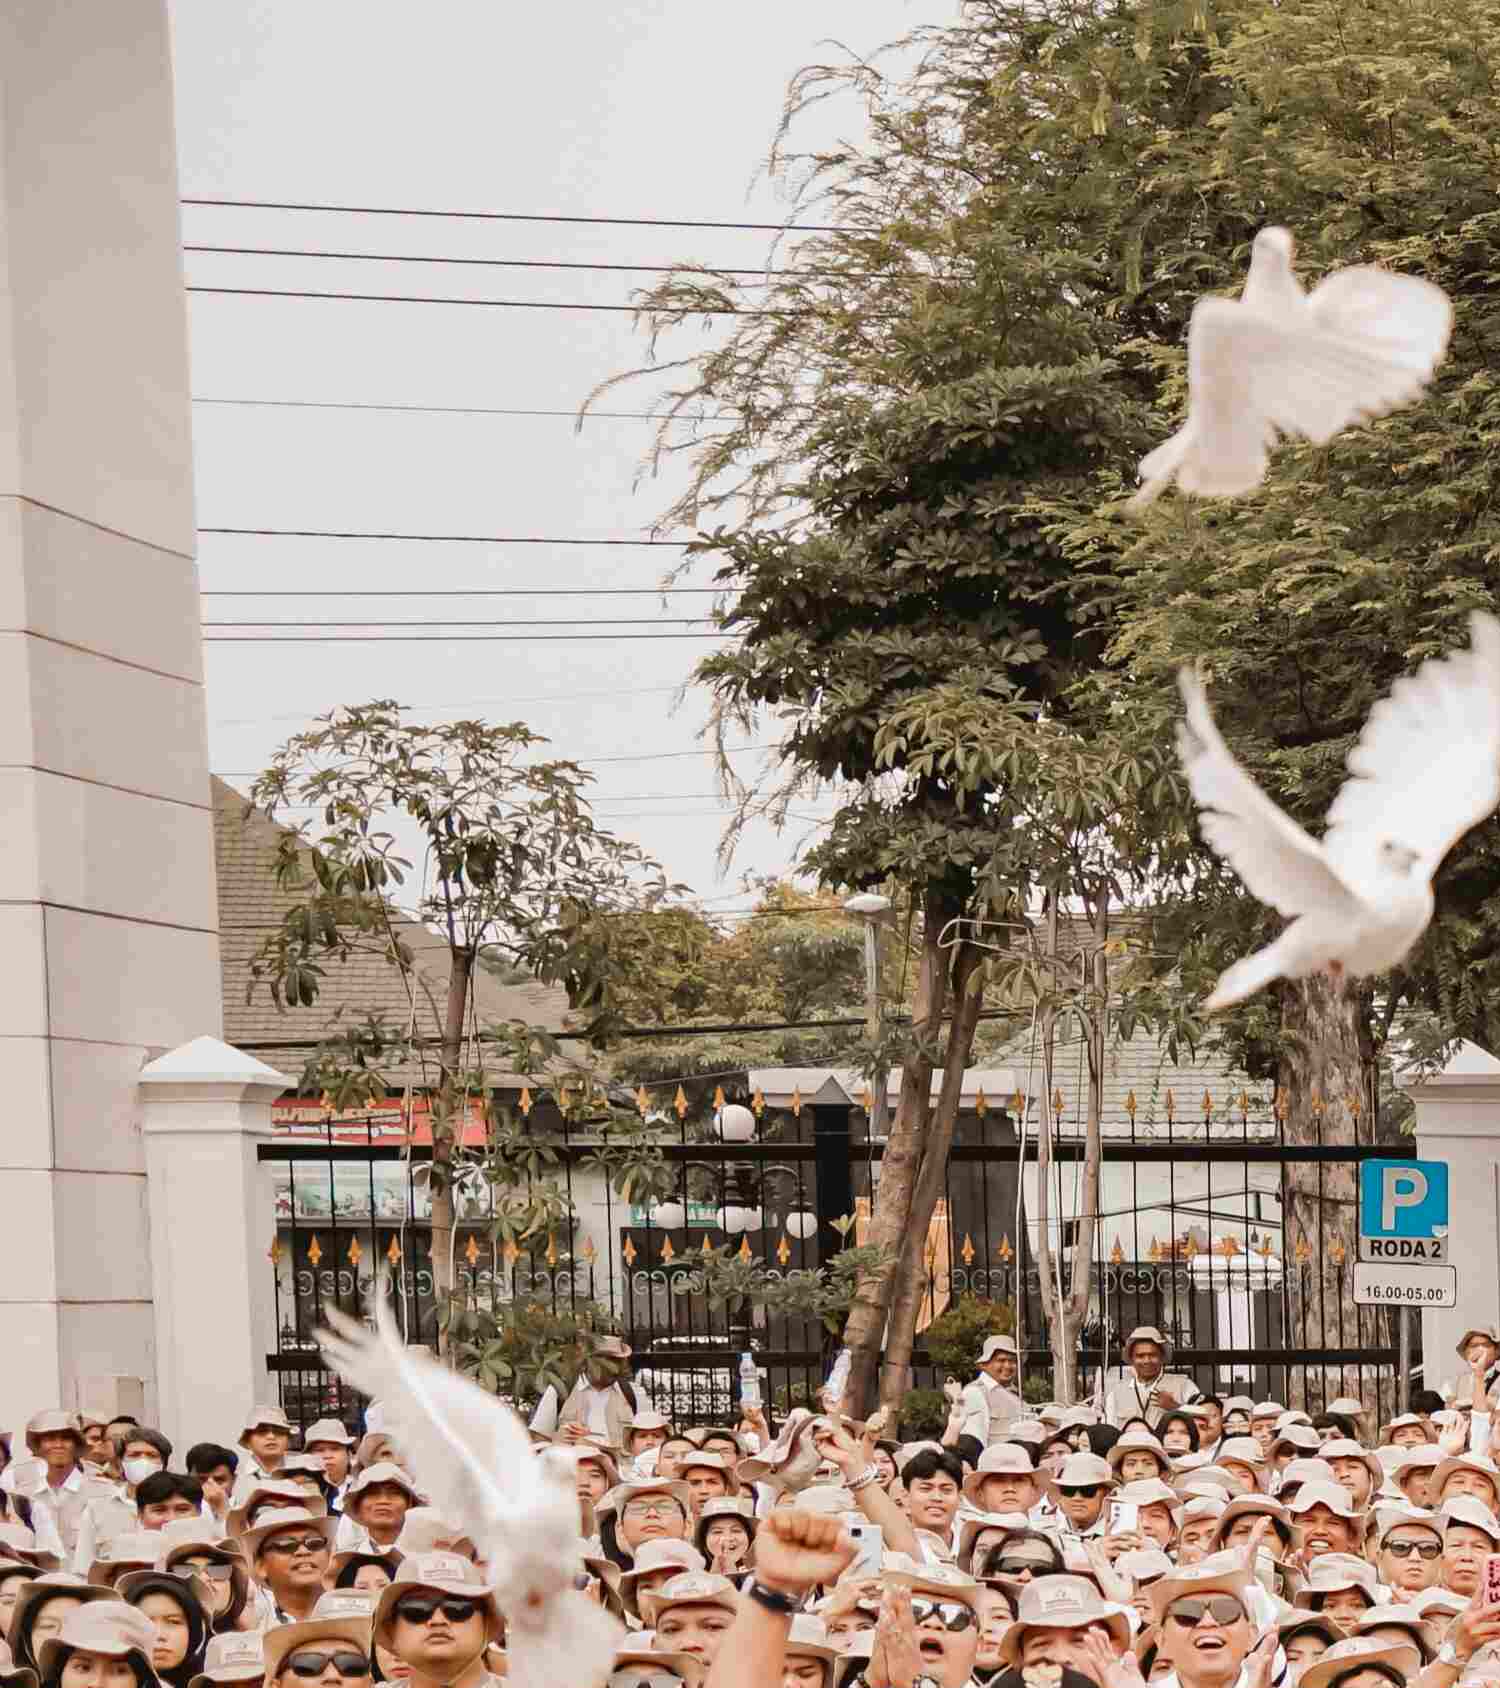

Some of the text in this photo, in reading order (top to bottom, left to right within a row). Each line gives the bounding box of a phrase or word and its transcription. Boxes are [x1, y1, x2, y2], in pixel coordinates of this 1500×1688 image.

[1381, 1167, 1429, 1231] P
[1369, 1239, 1442, 1258] RODA 2
